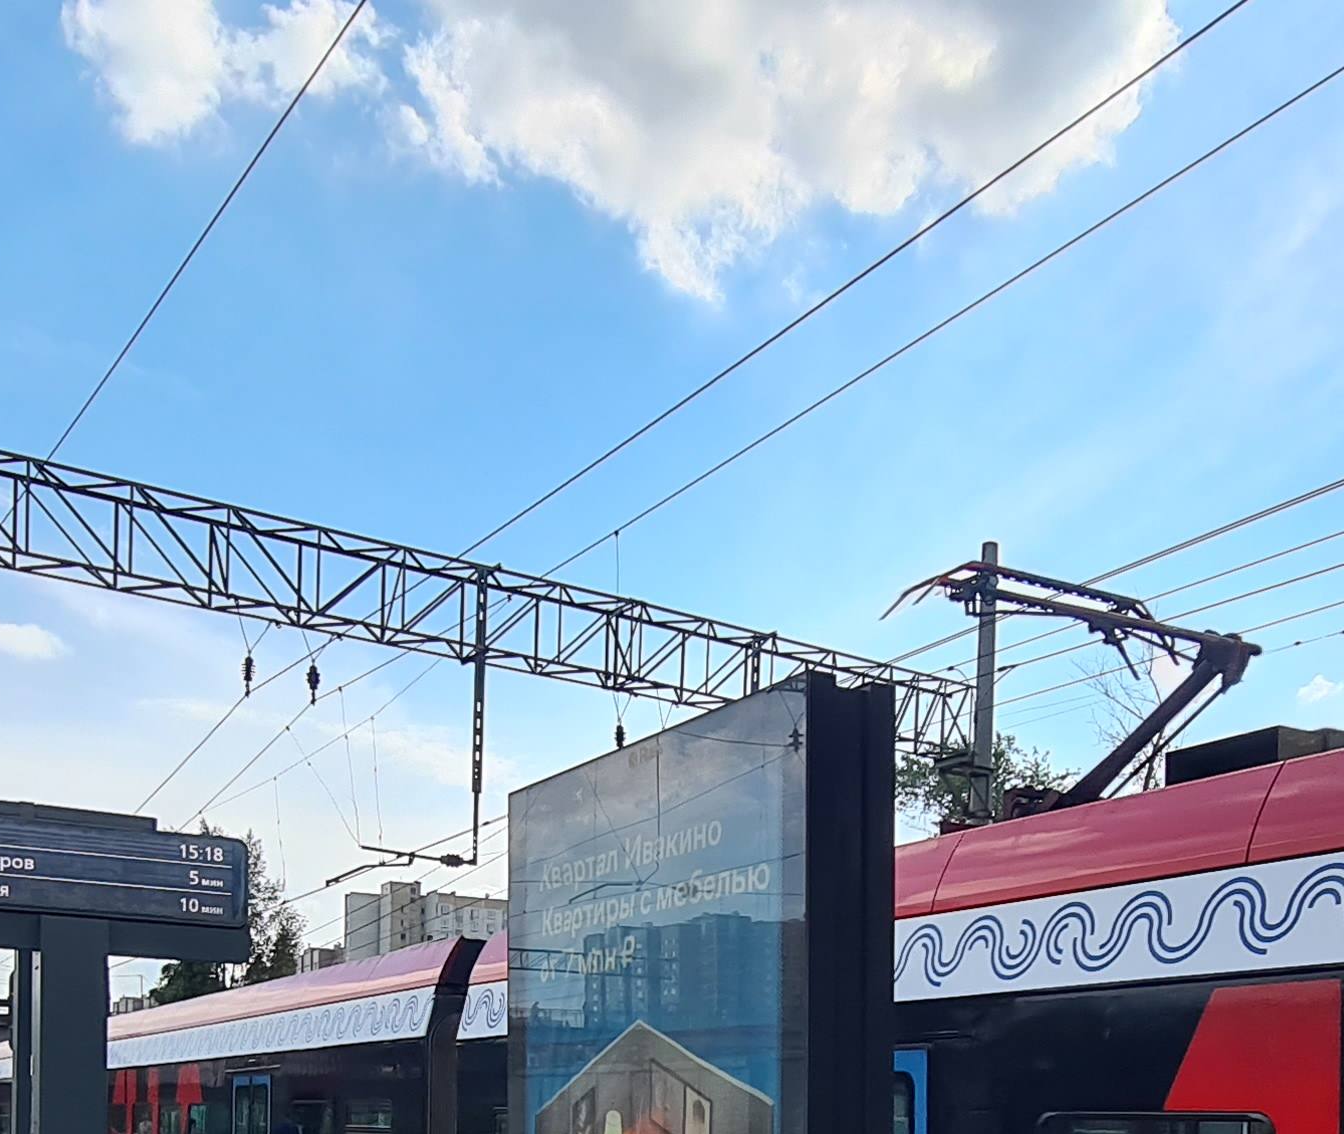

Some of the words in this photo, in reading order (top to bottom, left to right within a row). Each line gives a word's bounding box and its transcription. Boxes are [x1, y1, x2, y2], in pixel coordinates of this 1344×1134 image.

[179, 844, 224, 863] 15:18
[540, 850, 619, 892] Квартал
[625, 820, 723, 867] Ивакино
[189, 871, 200, 886] 5
[201, 877, 224, 888] мин
[180, 898, 199, 913] 10
[201, 904, 224, 916] мин
[542, 895, 635, 938] Квартиры
[640, 897, 652, 915] с
[656, 862, 771, 912] мебелью
[578, 947, 617, 975] млн
